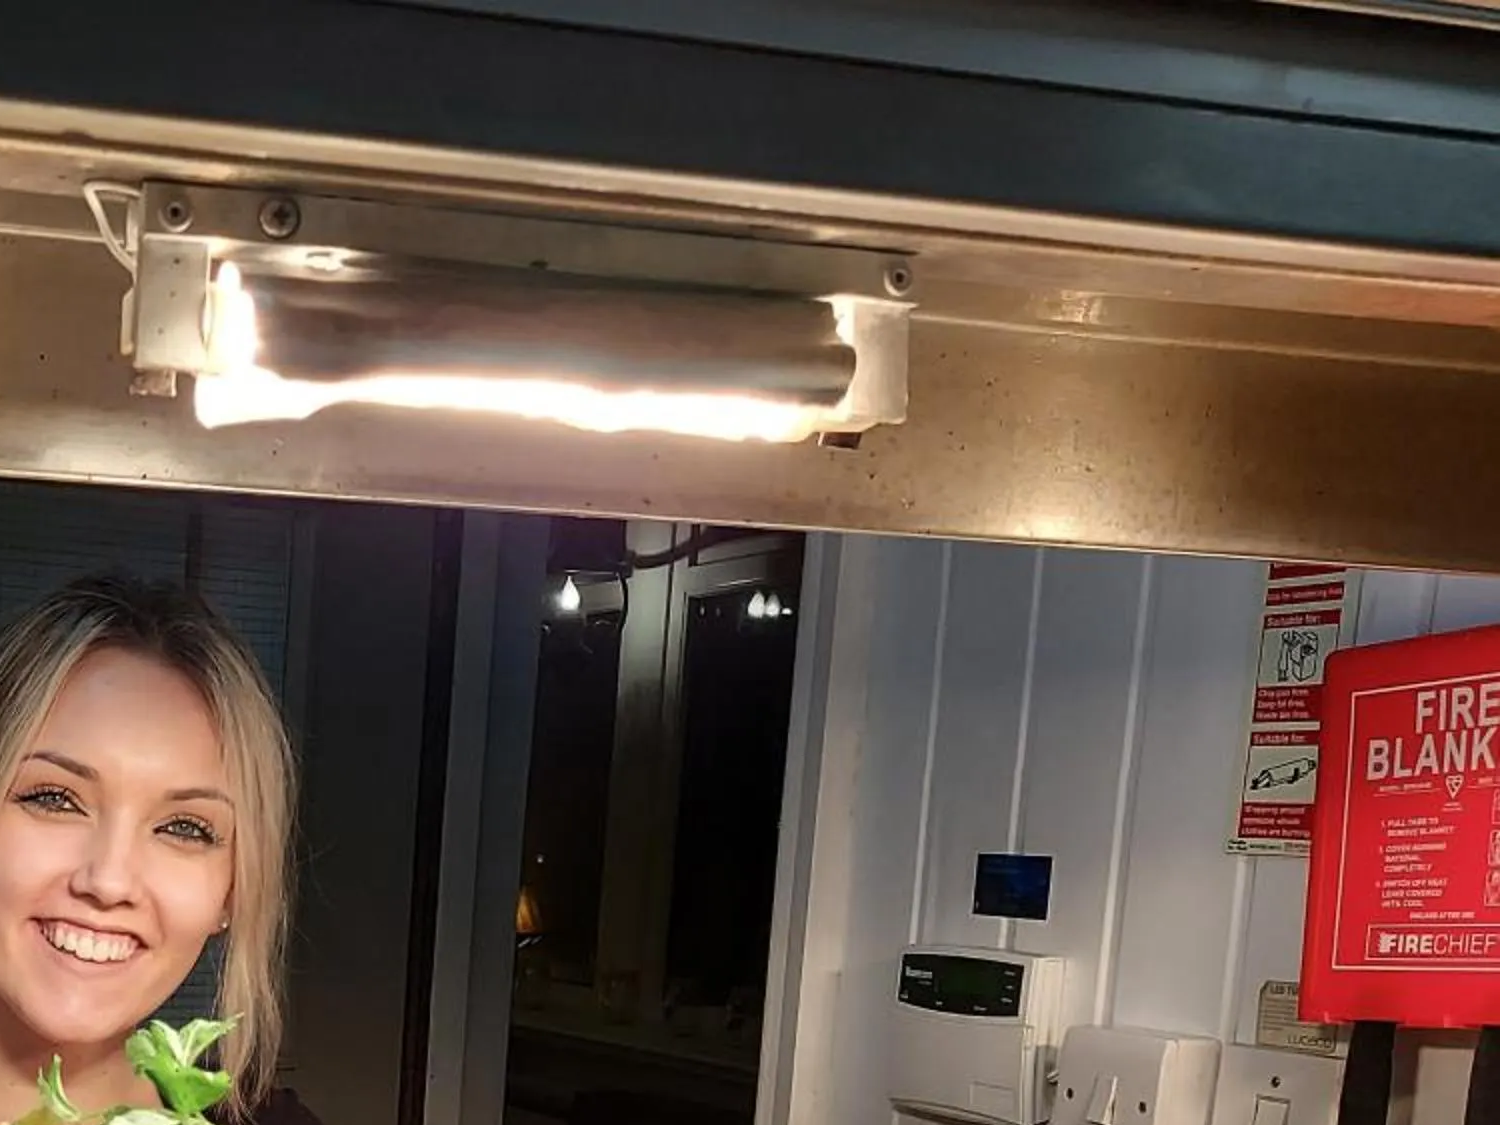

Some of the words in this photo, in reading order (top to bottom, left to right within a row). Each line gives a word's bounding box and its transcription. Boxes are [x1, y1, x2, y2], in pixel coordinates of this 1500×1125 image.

[1267, 614, 1303, 627] Suitable
[1415, 681, 1500, 735] FIRE
[1253, 733, 1288, 744] Suitable
[1367, 725, 1498, 780] BLANK
[1382, 932, 1498, 955] FIRECHIEF
